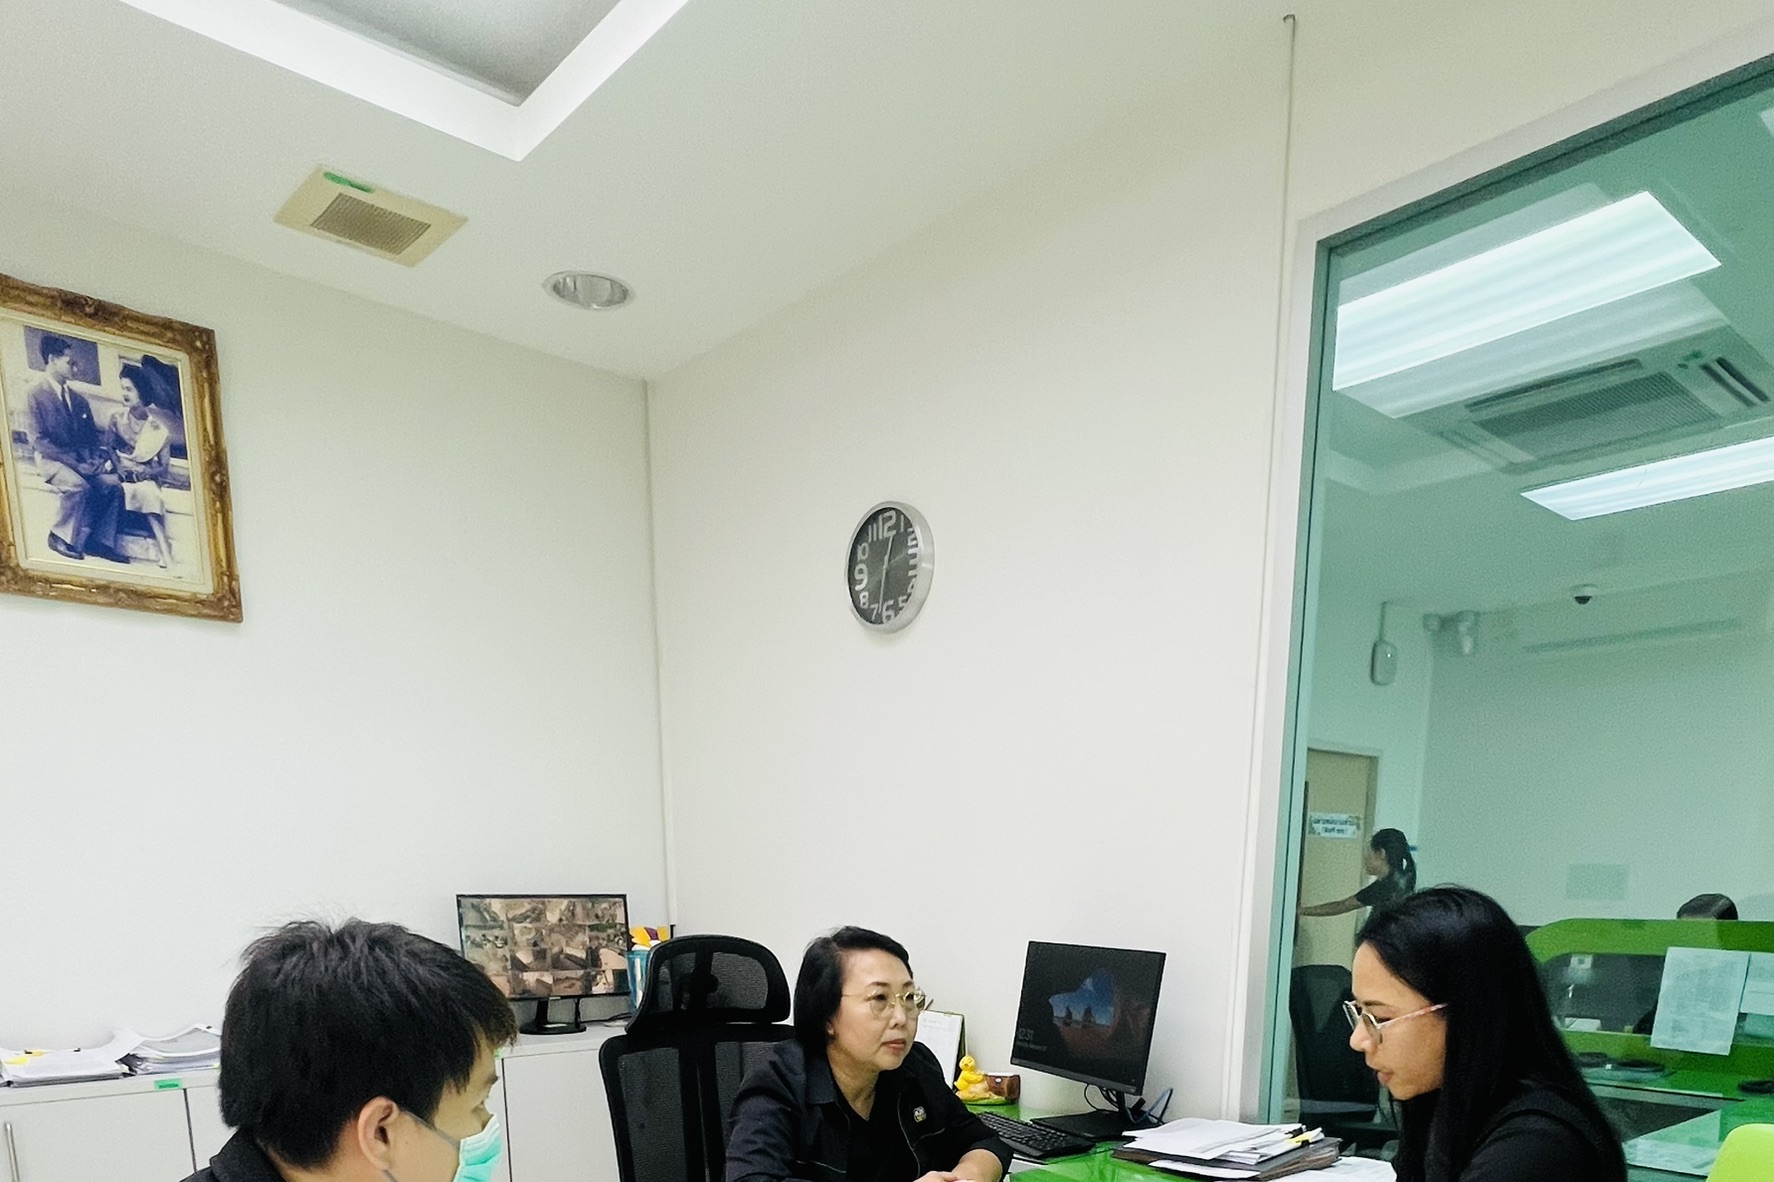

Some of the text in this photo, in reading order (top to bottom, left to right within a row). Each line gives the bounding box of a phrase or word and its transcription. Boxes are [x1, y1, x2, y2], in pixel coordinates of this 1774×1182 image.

[867, 523, 877, 543] 11
[878, 509, 897, 540] 12
[907, 527, 918, 546] 2
[857, 542, 869, 562] 10
[854, 563, 868, 591] 9
[859, 591, 870, 609] 8
[870, 602, 879, 621] 7
[881, 599, 896, 624] 6
